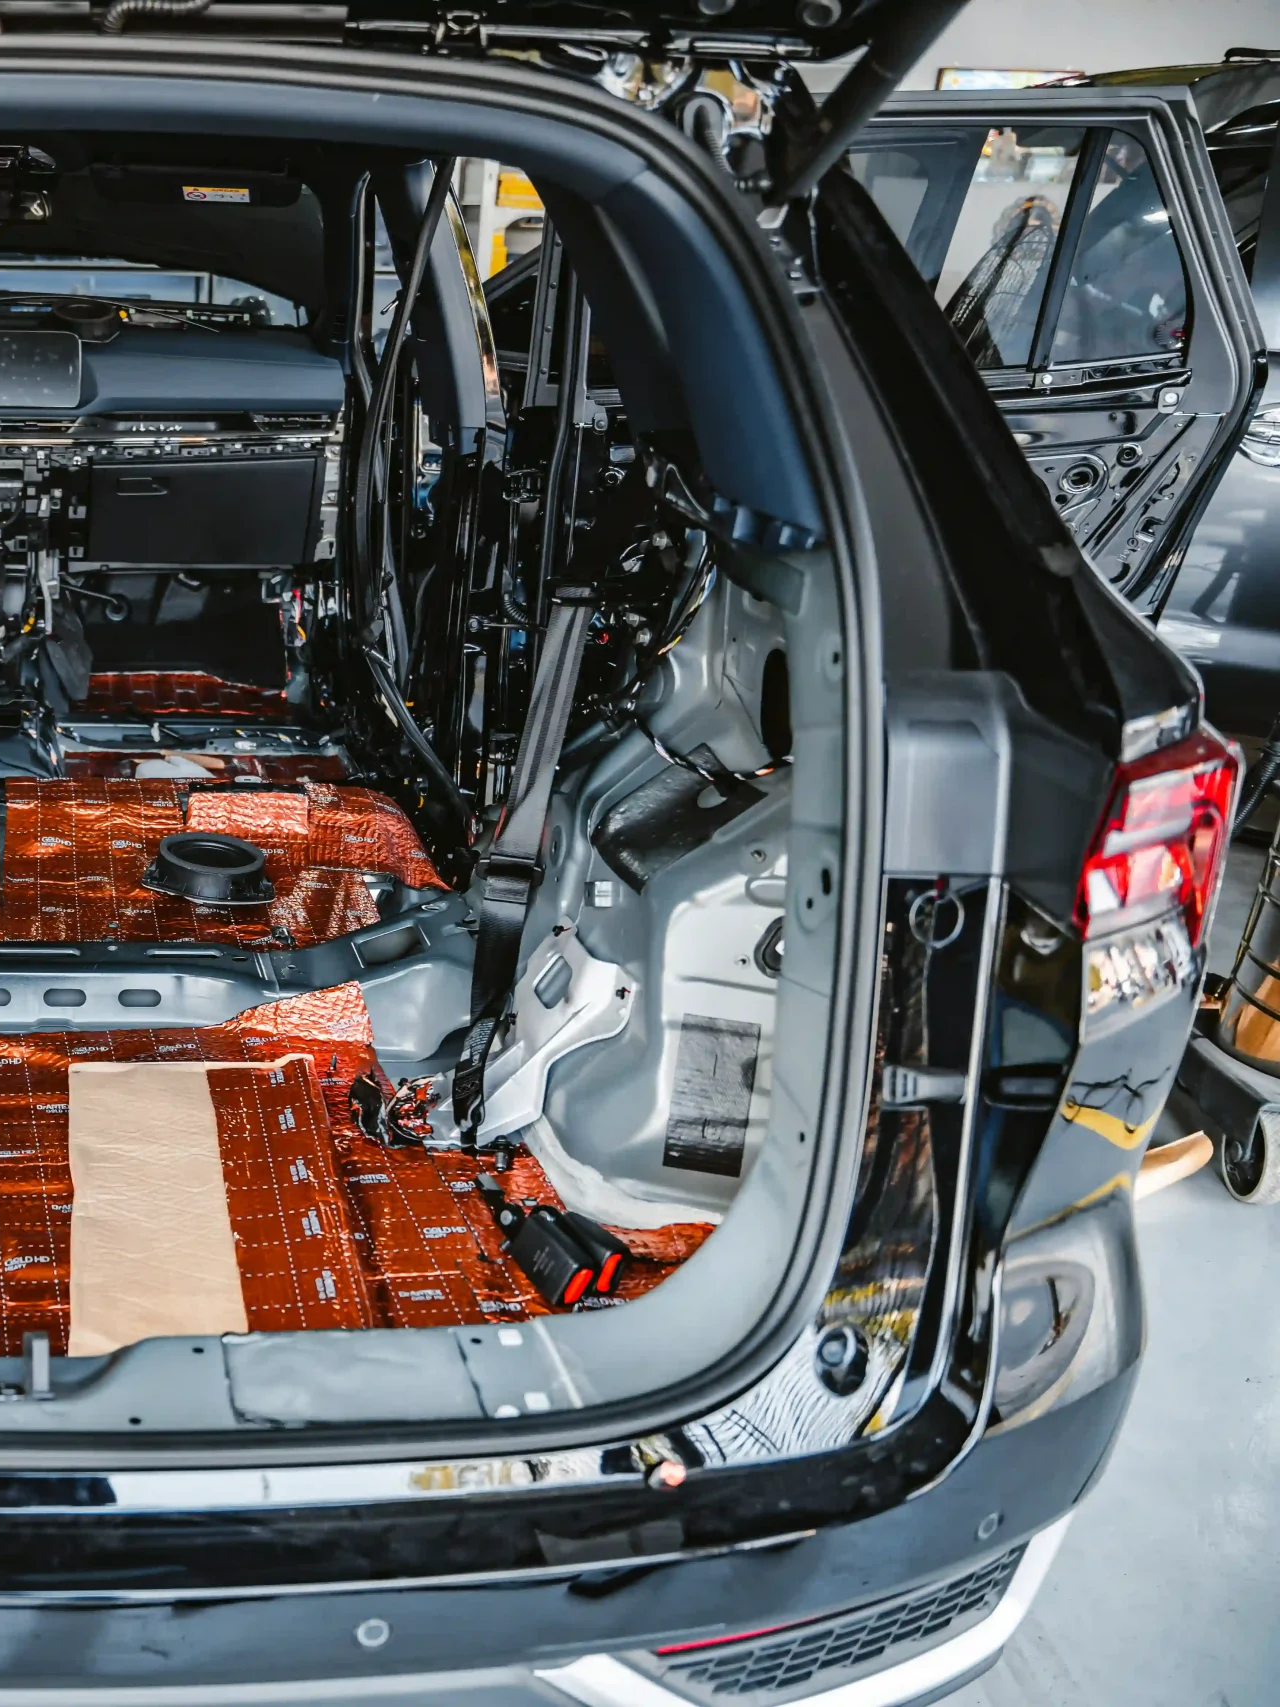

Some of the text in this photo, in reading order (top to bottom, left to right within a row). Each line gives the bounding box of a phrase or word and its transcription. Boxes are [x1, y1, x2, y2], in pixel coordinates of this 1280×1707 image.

[41, 836, 60, 844] GOLD
[423, 1226, 452, 1234] GOLD
[354, 1232, 365, 1240] D
[3, 1255, 50, 1266] GOLD HD
